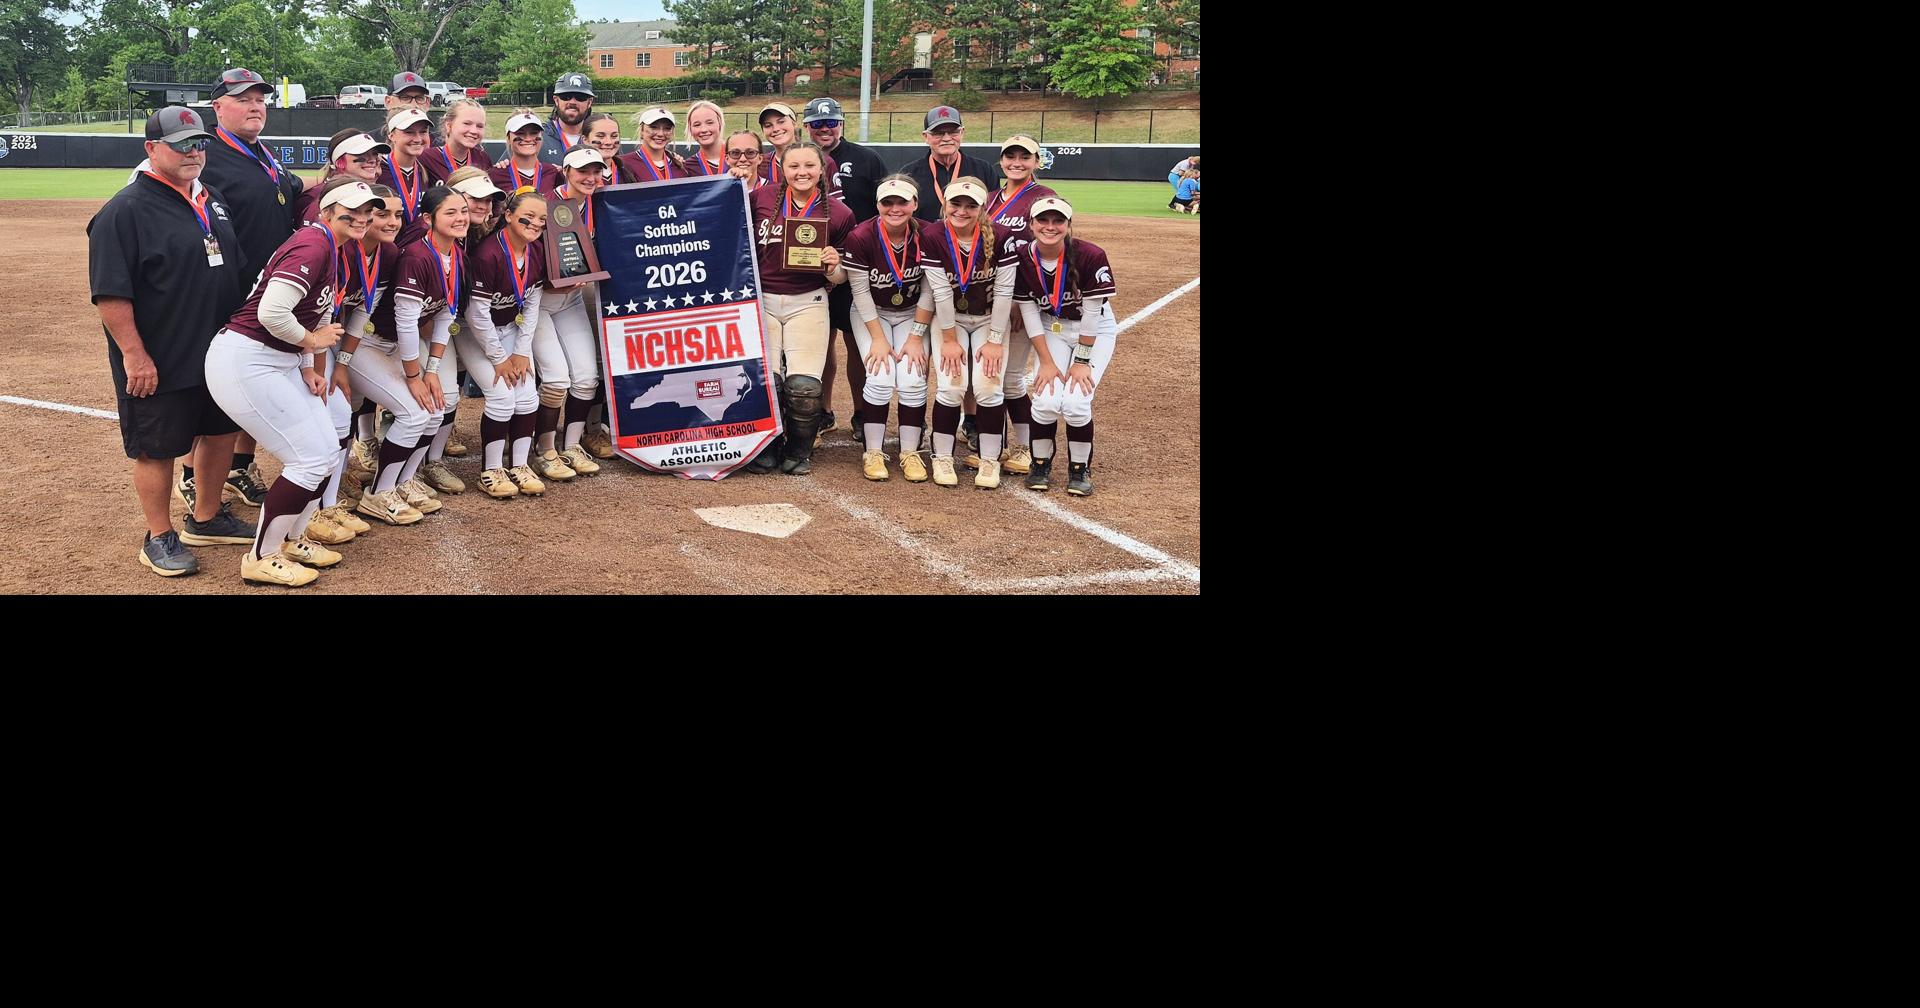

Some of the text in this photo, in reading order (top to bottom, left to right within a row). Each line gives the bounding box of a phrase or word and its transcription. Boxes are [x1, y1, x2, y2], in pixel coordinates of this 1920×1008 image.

[11, 142, 37, 150] 2024
[12, 135, 36, 143] 2021
[1057, 147, 1082, 155] 2024
[658, 205, 677, 219] 6A
[644, 220, 696, 239] Softball
[635, 239, 711, 258] Champions
[645, 260, 707, 289] 2026
[624, 322, 746, 371] NCHSAA
[636, 423, 757, 447] NORTH CAROLINA HIGH SCHOOL
[672, 442, 727, 456] ATHLETIC
[660, 450, 742, 467] ASSOCIATION
